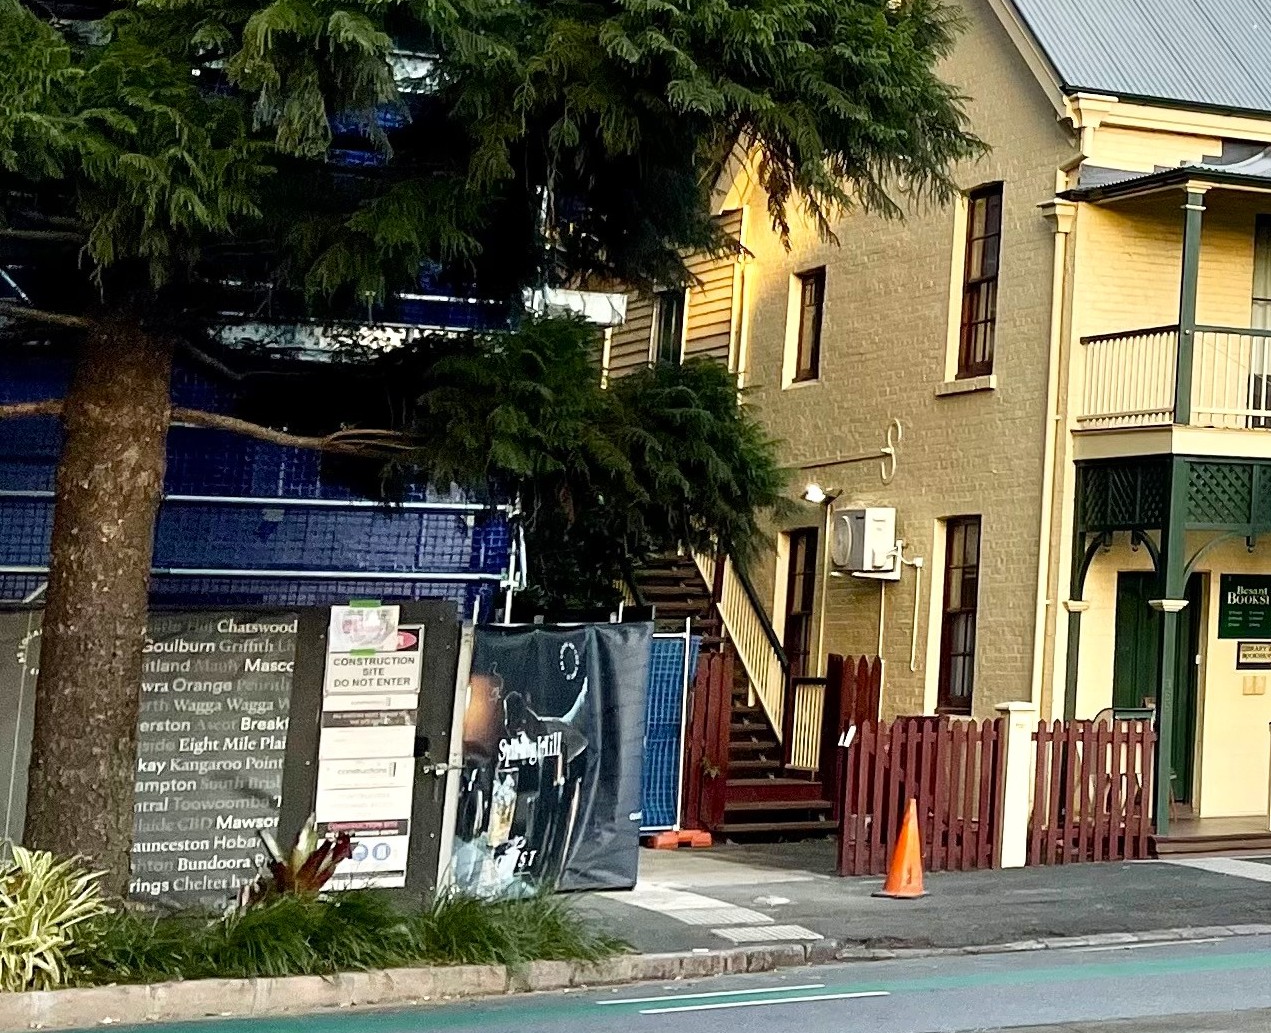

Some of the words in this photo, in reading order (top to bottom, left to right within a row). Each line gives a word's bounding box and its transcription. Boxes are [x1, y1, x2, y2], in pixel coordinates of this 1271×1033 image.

[217, 619, 298, 634] Chatswood
[142, 639, 215, 653] Goulburn
[333, 656, 415, 666] CONSTRUCTION
[362, 668, 385, 676] SITE
[172, 678, 233, 694] Orange
[333, 678, 349, 688] DO
[352, 678, 374, 687] NOT
[376, 677, 411, 687] ENTER
[173, 698, 222, 716] Wagga
[226, 698, 274, 715] Wagga
[179, 736, 219, 755] Eight
[222, 736, 256, 751] Mile
[137, 758, 166, 775] kay
[170, 758, 242, 774] Kangaroo
[213, 836, 262, 850] Hobar
[177, 855, 250, 872] Bundoora
[129, 878, 170, 895] rings
